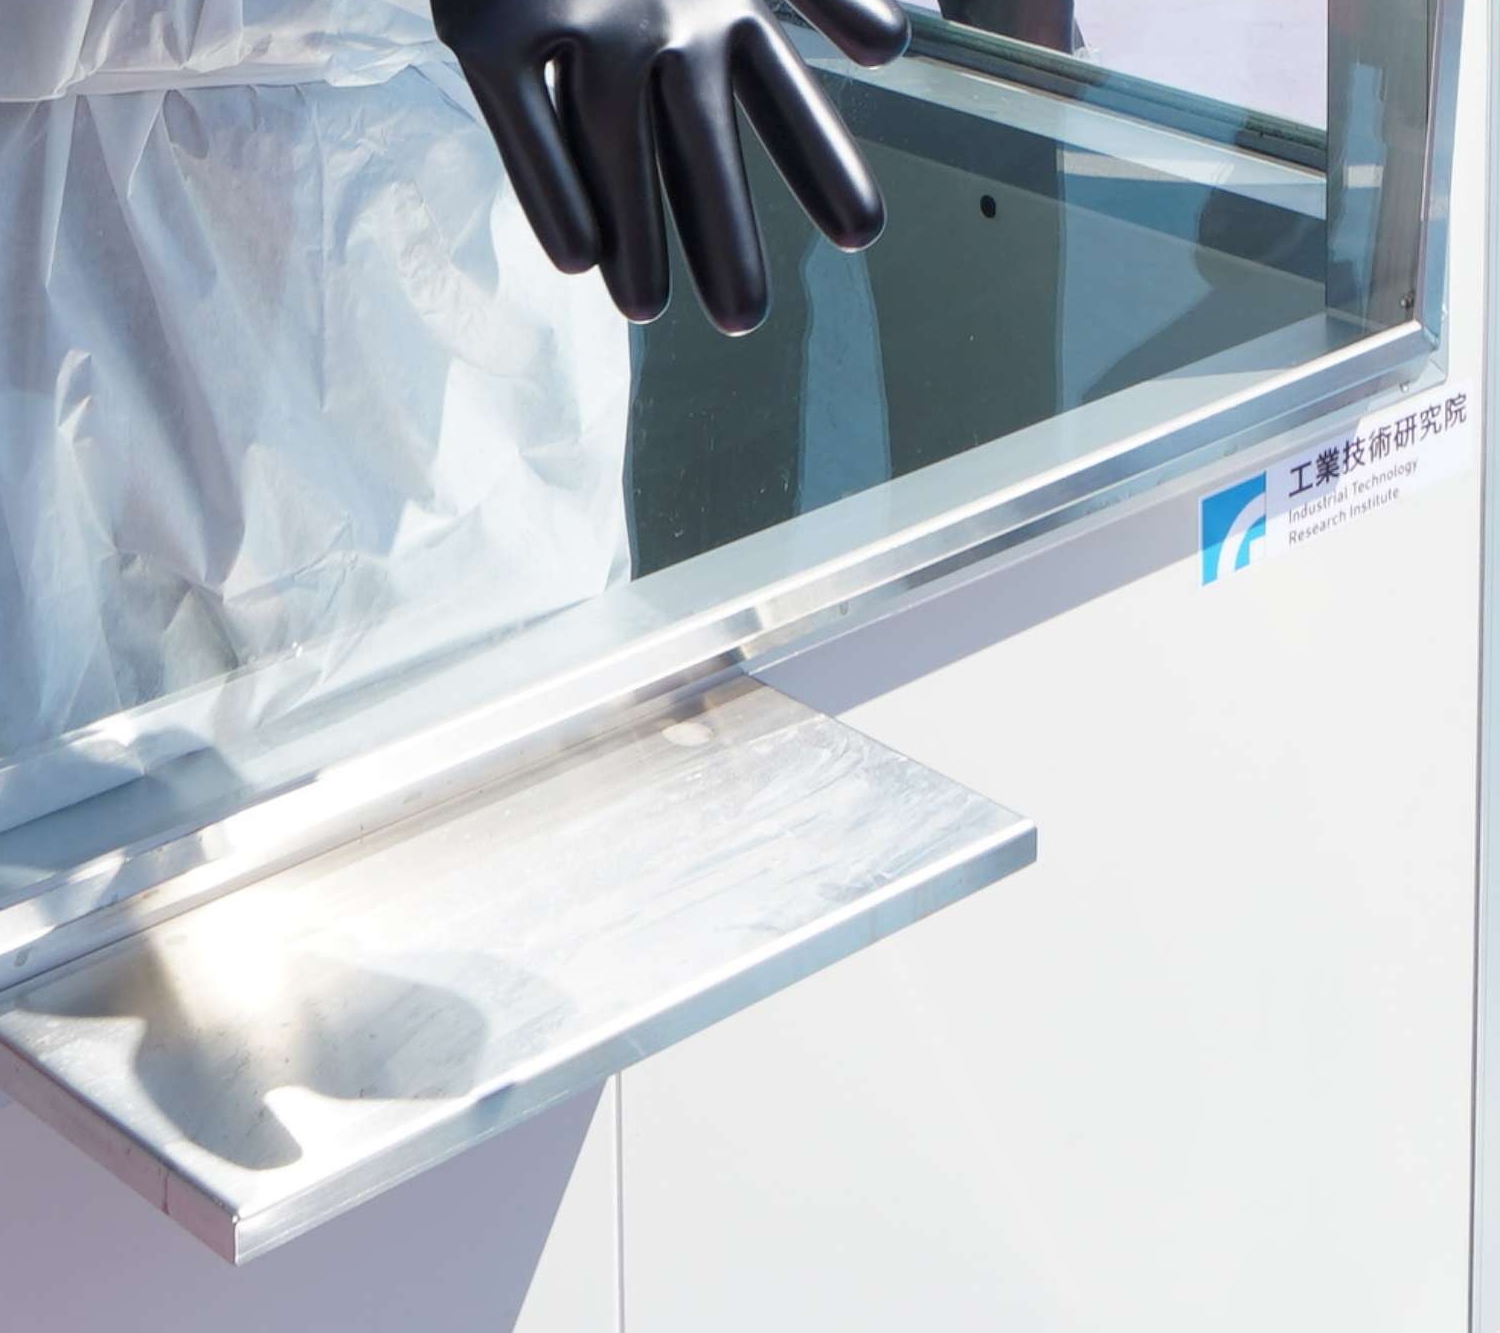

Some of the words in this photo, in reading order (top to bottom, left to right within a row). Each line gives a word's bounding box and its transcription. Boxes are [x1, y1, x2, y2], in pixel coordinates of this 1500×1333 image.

[1287, 393, 1468, 498] 工業技術研究院
[1288, 486, 1348, 525] Industrial
[1351, 457, 1419, 496] Technology
[1288, 511, 1347, 546] Research
[1349, 486, 1400, 519] Institute
